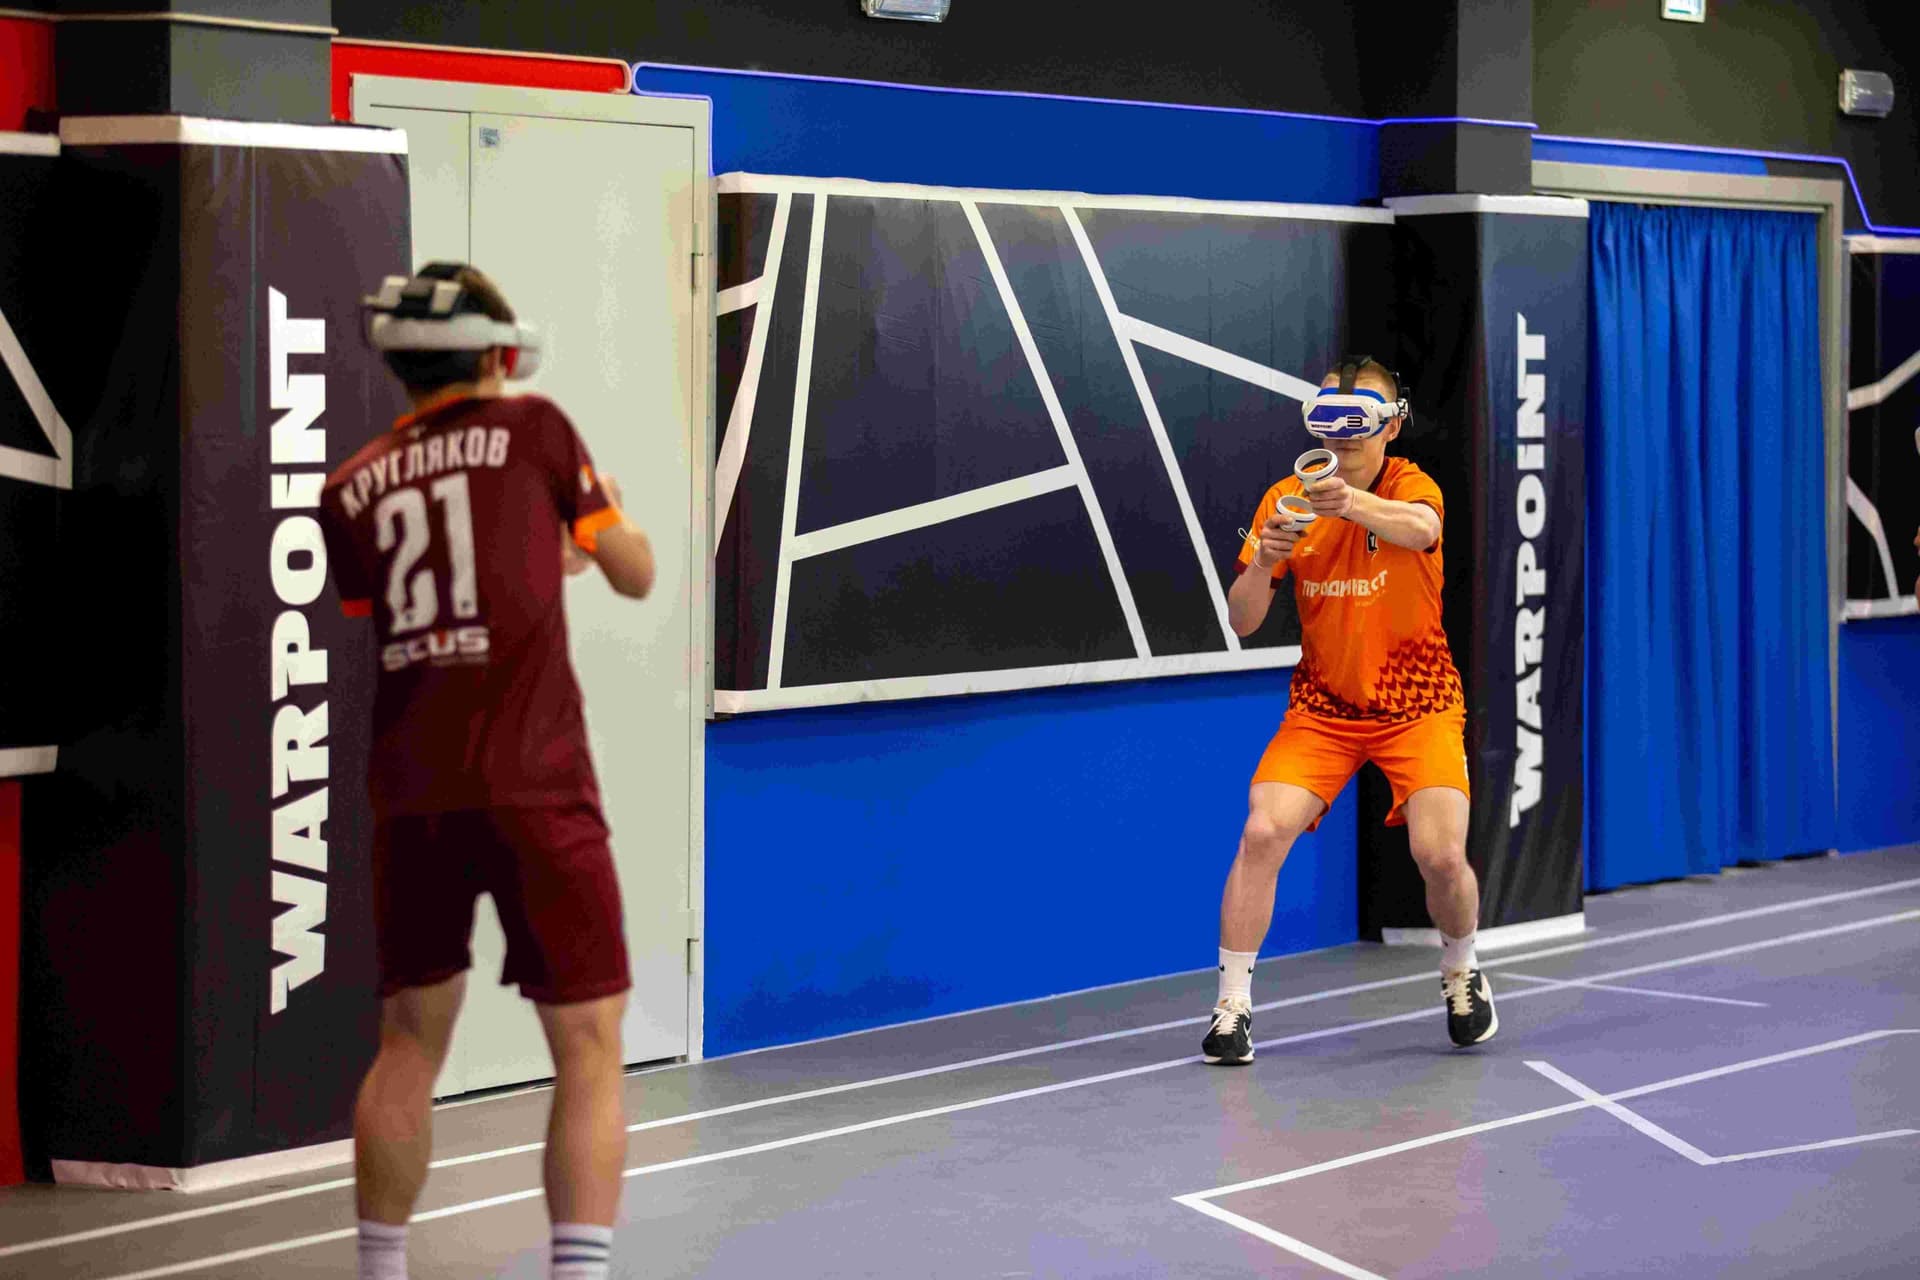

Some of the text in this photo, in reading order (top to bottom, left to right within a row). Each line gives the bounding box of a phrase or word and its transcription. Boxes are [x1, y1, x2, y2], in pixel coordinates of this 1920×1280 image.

[340, 426, 510, 519] КРУГЛЯКОВ
[375, 471, 478, 636] 21
[1510, 312, 1546, 829] WARPOINT
[269, 285, 328, 1015] WARPOINT
